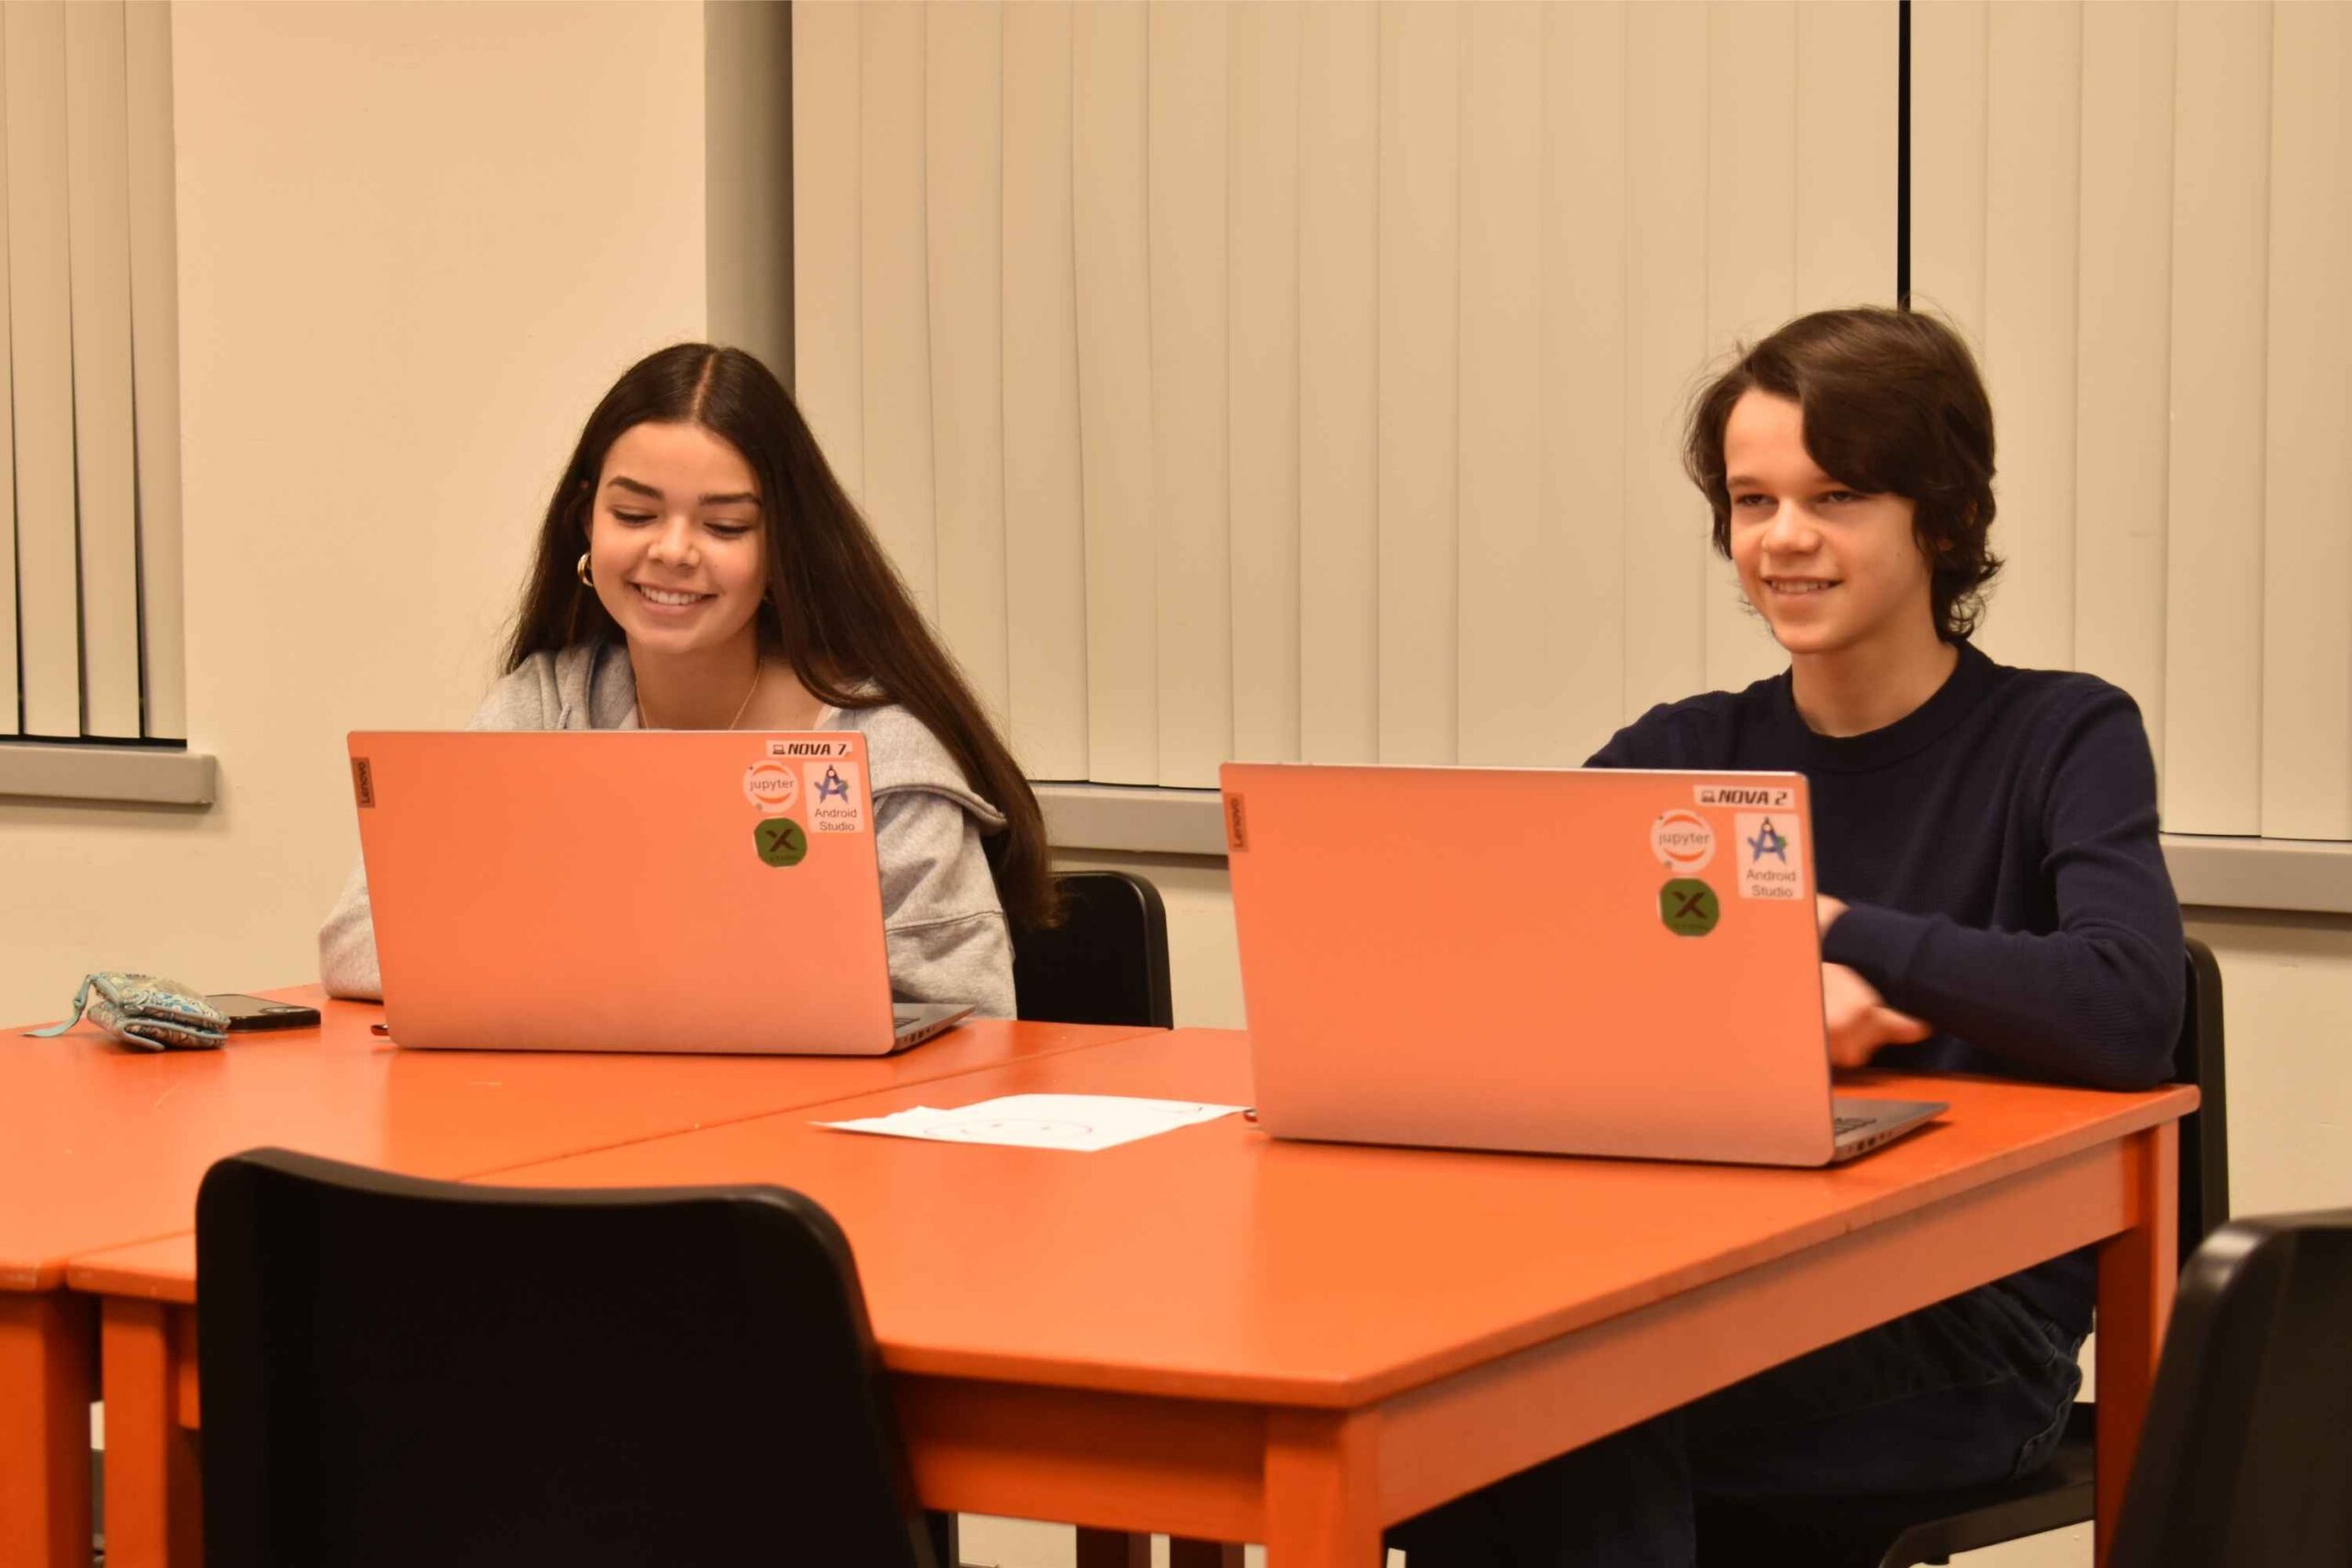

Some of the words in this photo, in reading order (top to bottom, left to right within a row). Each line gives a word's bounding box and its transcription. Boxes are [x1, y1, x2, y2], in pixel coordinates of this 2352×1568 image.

[787, 743, 831, 755] NOVA
[838, 743, 847, 755] 7
[358, 761, 370, 804] Lenovo
[750, 778, 795, 791] jupyter
[1718, 789, 1770, 805] NOVA
[1774, 791, 1788, 806] 2
[814, 808, 857, 818] Android
[820, 821, 855, 831] Studio
[1230, 797, 1243, 848] Lenovo
[1658, 831, 1711, 846] jupyter
[1746, 869, 1795, 882] Android
[1751, 885, 1792, 897] Studio
